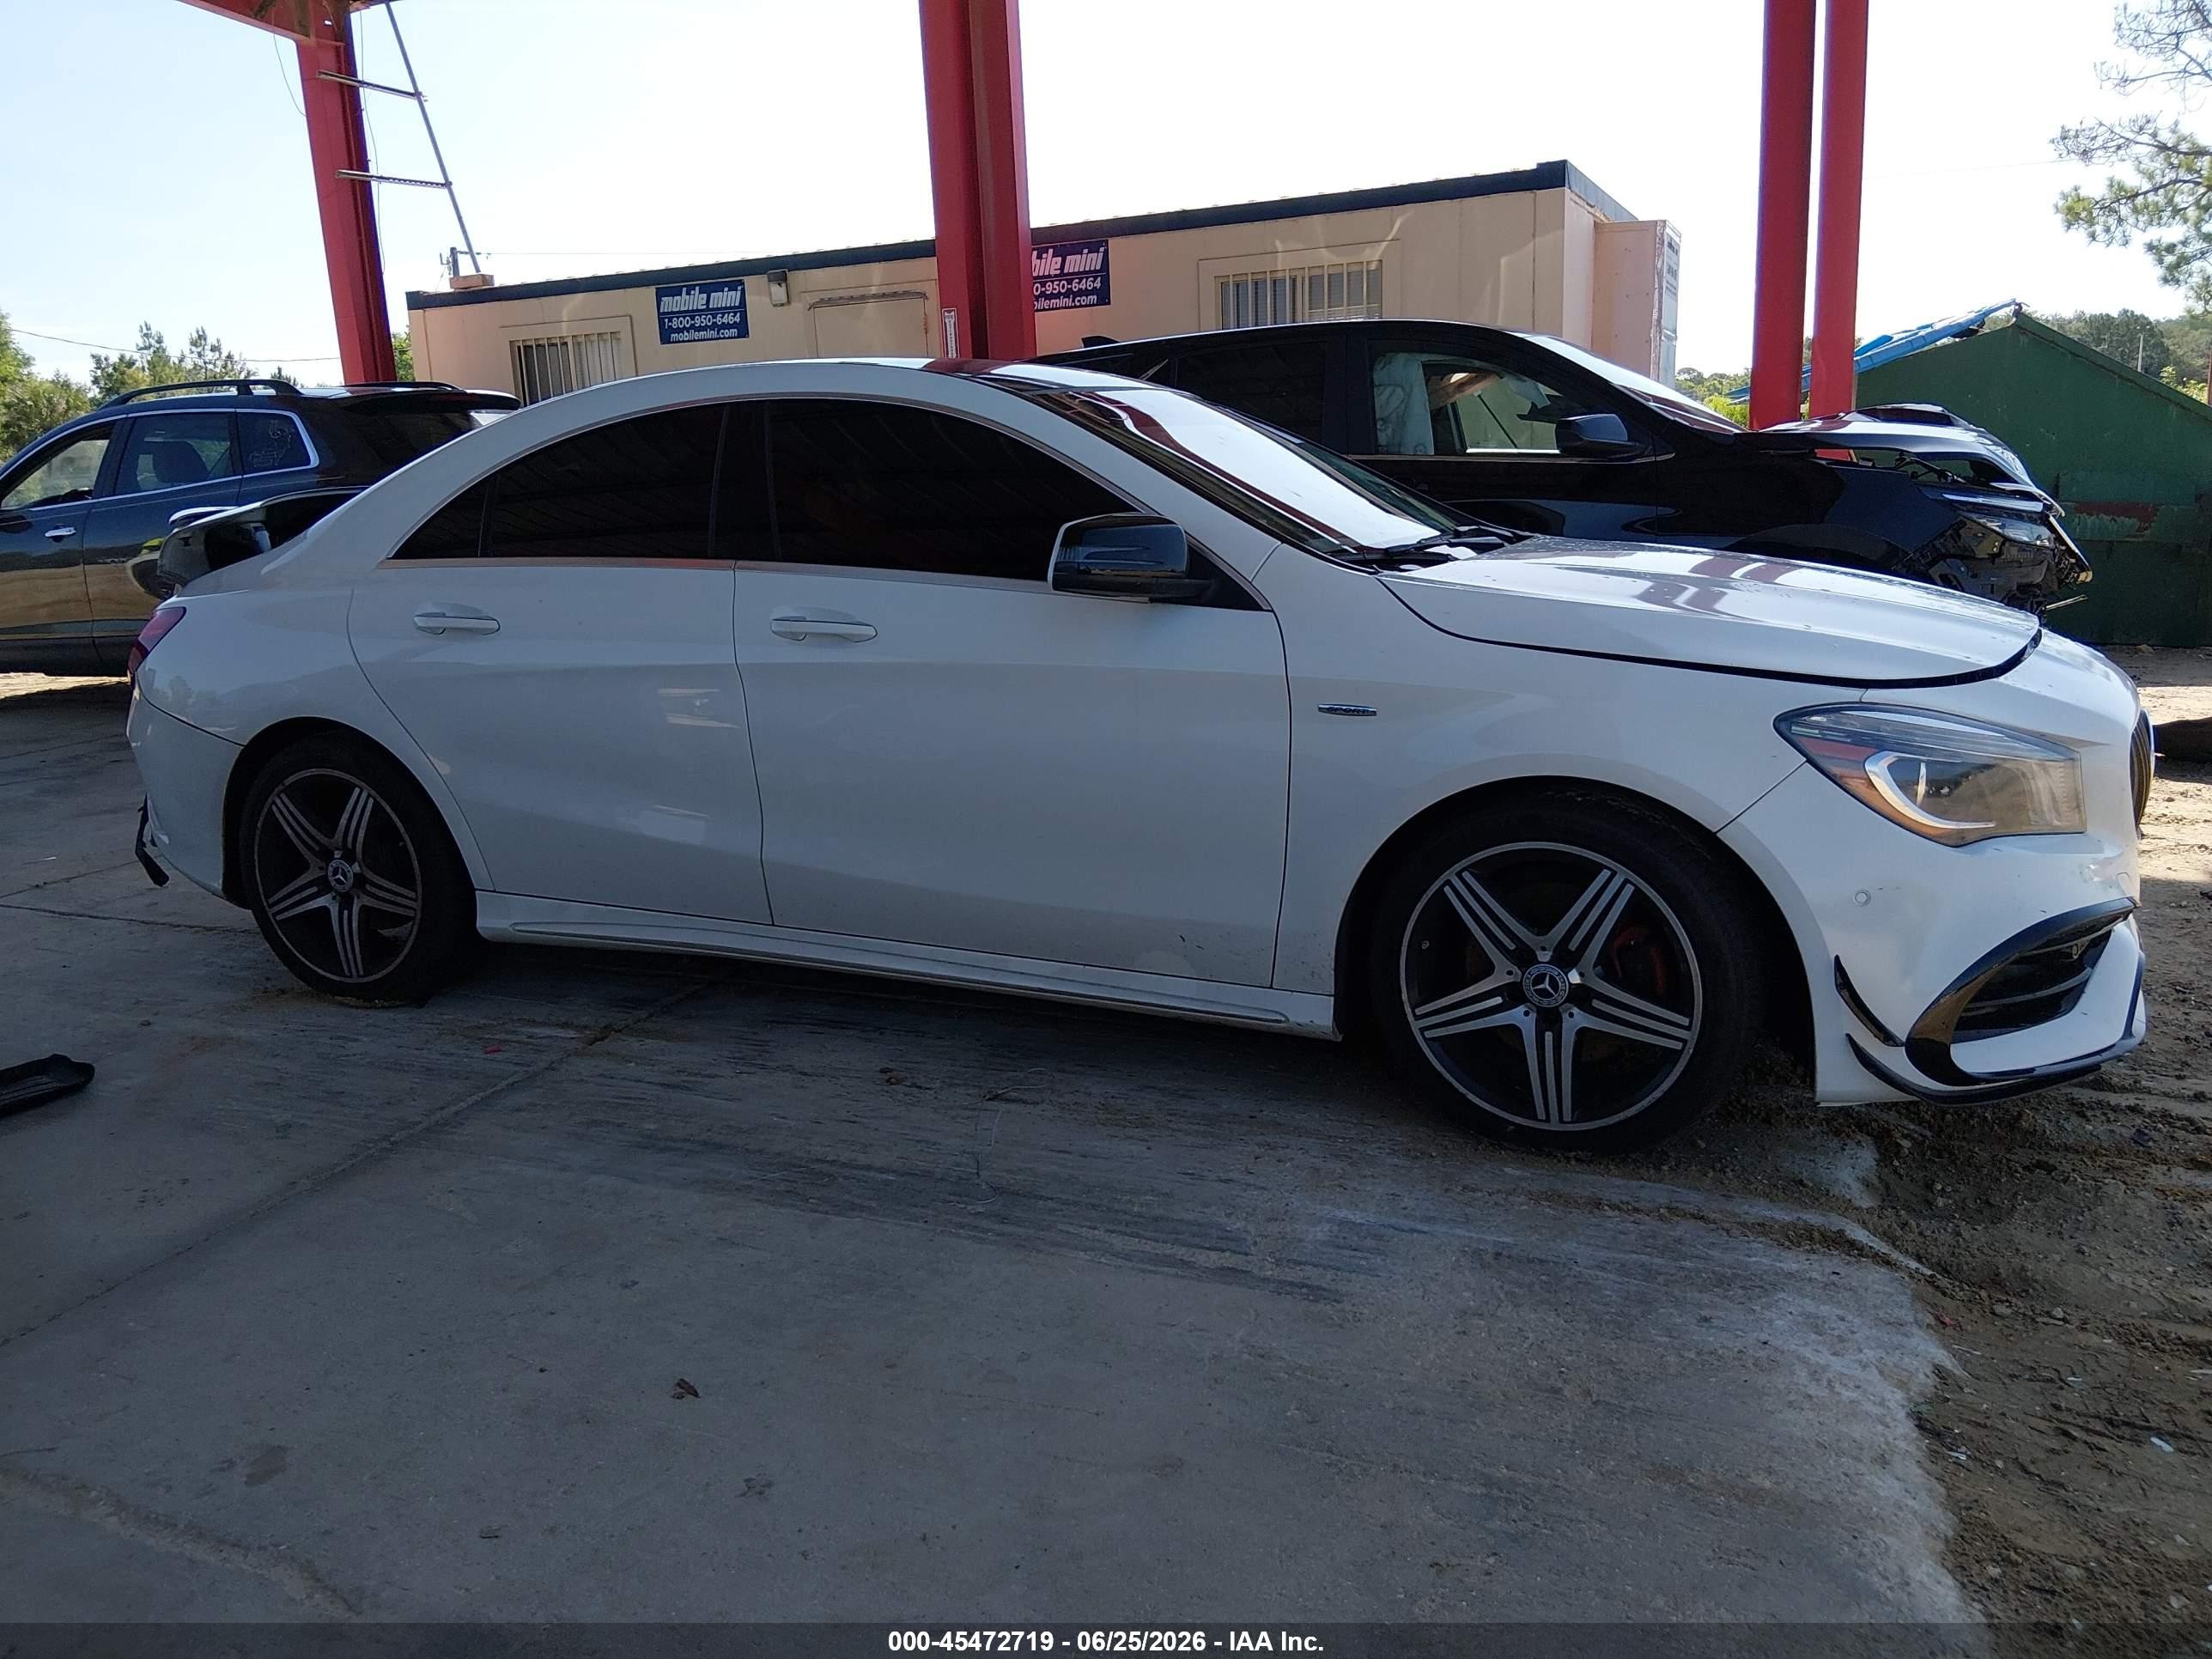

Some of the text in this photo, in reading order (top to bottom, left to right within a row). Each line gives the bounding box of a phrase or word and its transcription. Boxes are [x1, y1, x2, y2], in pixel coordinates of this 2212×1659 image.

[1031, 246, 1104, 276] bile mini
[1033, 277, 1101, 295] 0-950-6464
[659, 286, 741, 313] mobile mini
[664, 313, 740, 329] 1-800-950-6464
[671, 328, 738, 342] mobilemini.com
